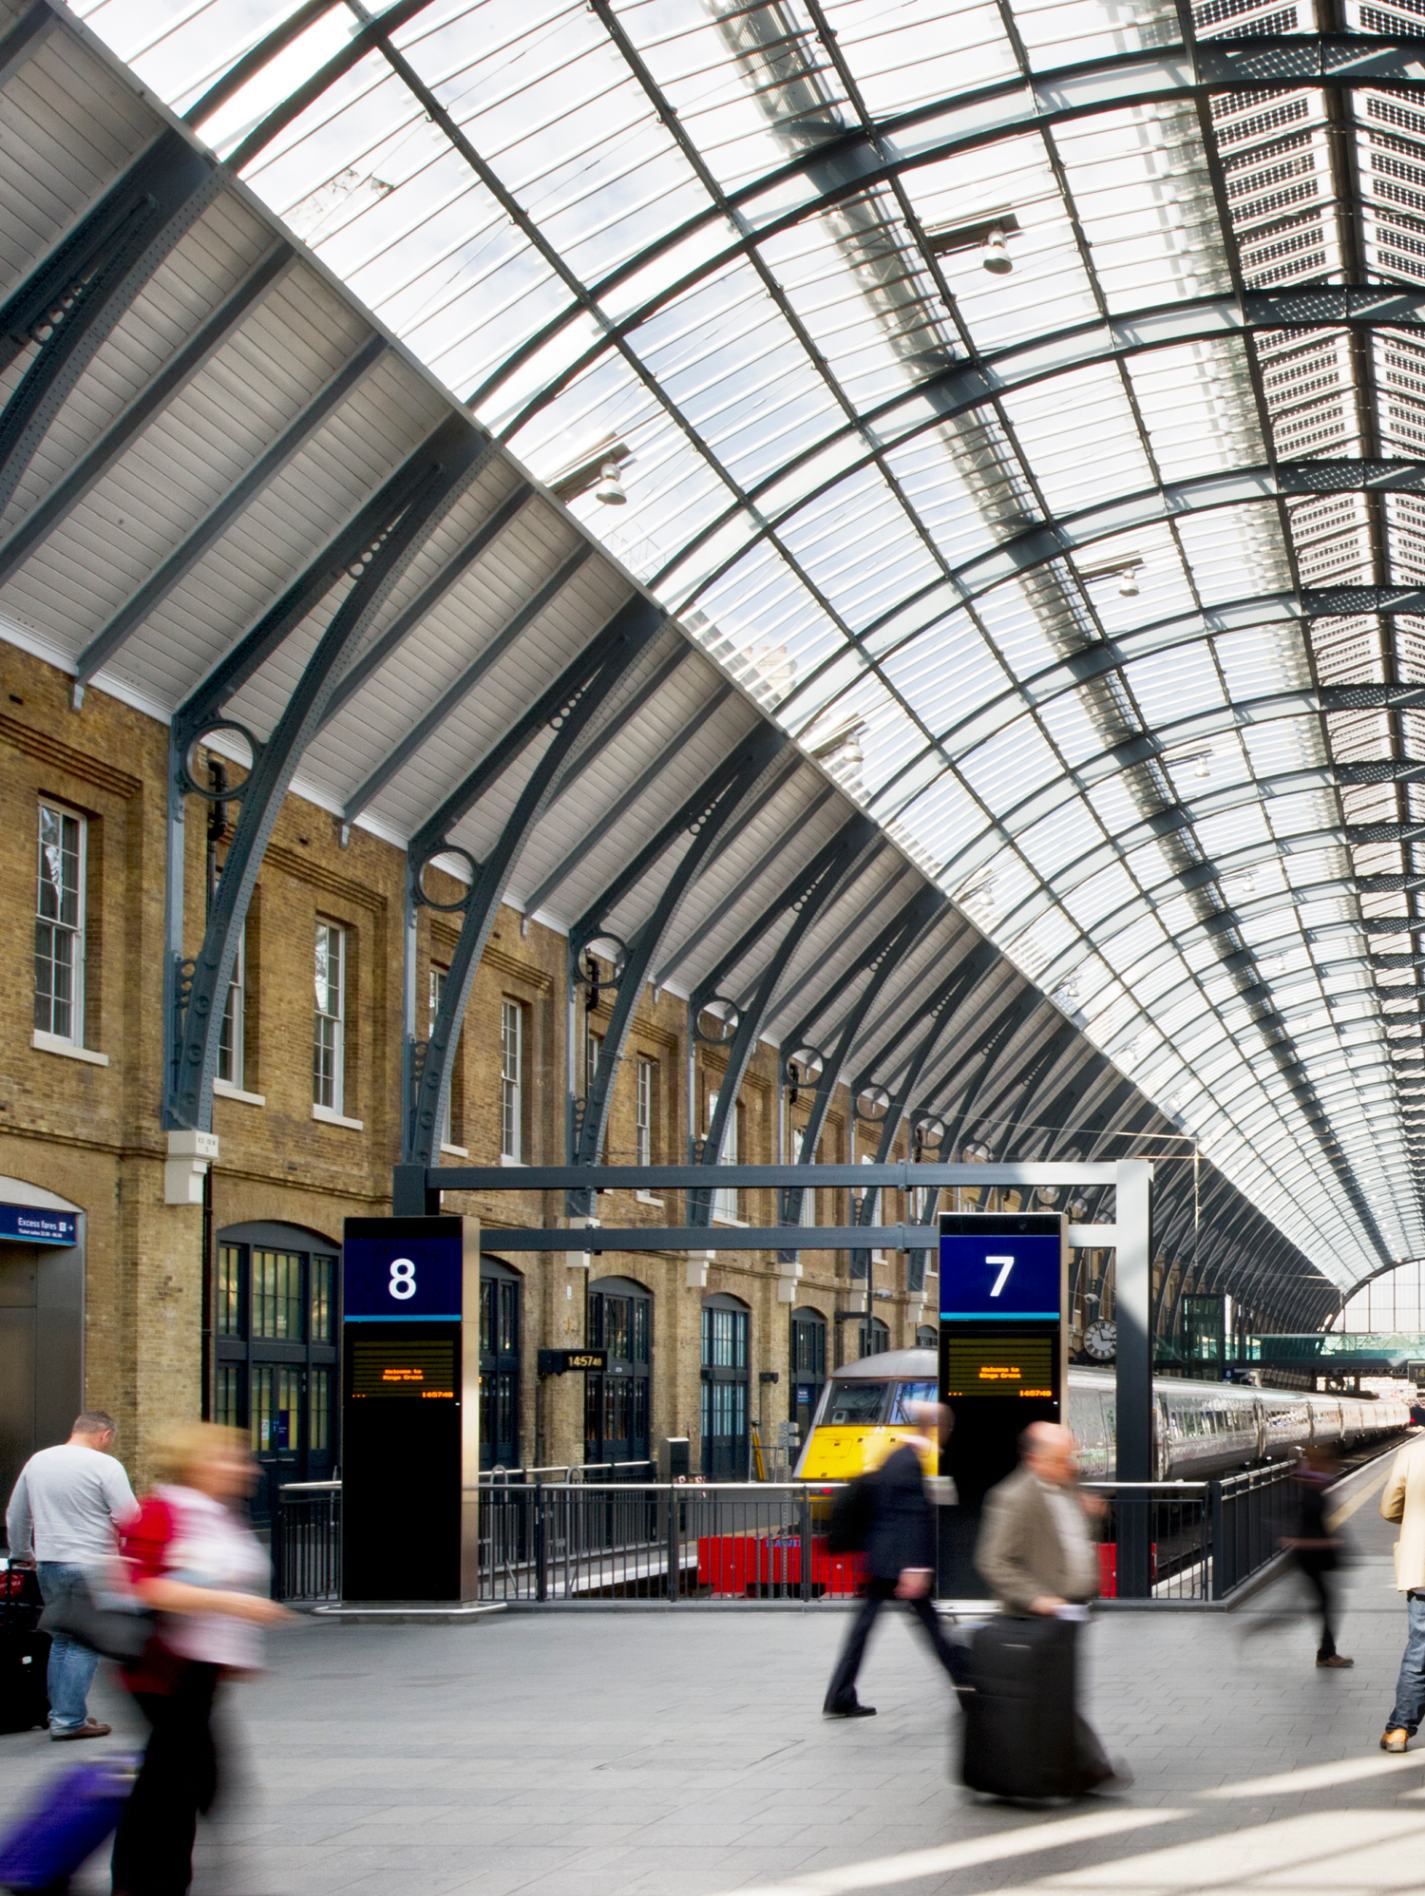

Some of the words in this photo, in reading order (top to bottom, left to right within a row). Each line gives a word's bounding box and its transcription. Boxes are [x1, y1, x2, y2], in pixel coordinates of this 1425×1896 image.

[18, 1217, 40, 1228] Excess
[41, 1220, 57, 1230] fares
[388, 1258, 417, 1300] 8
[985, 1255, 1015, 1297] 7
